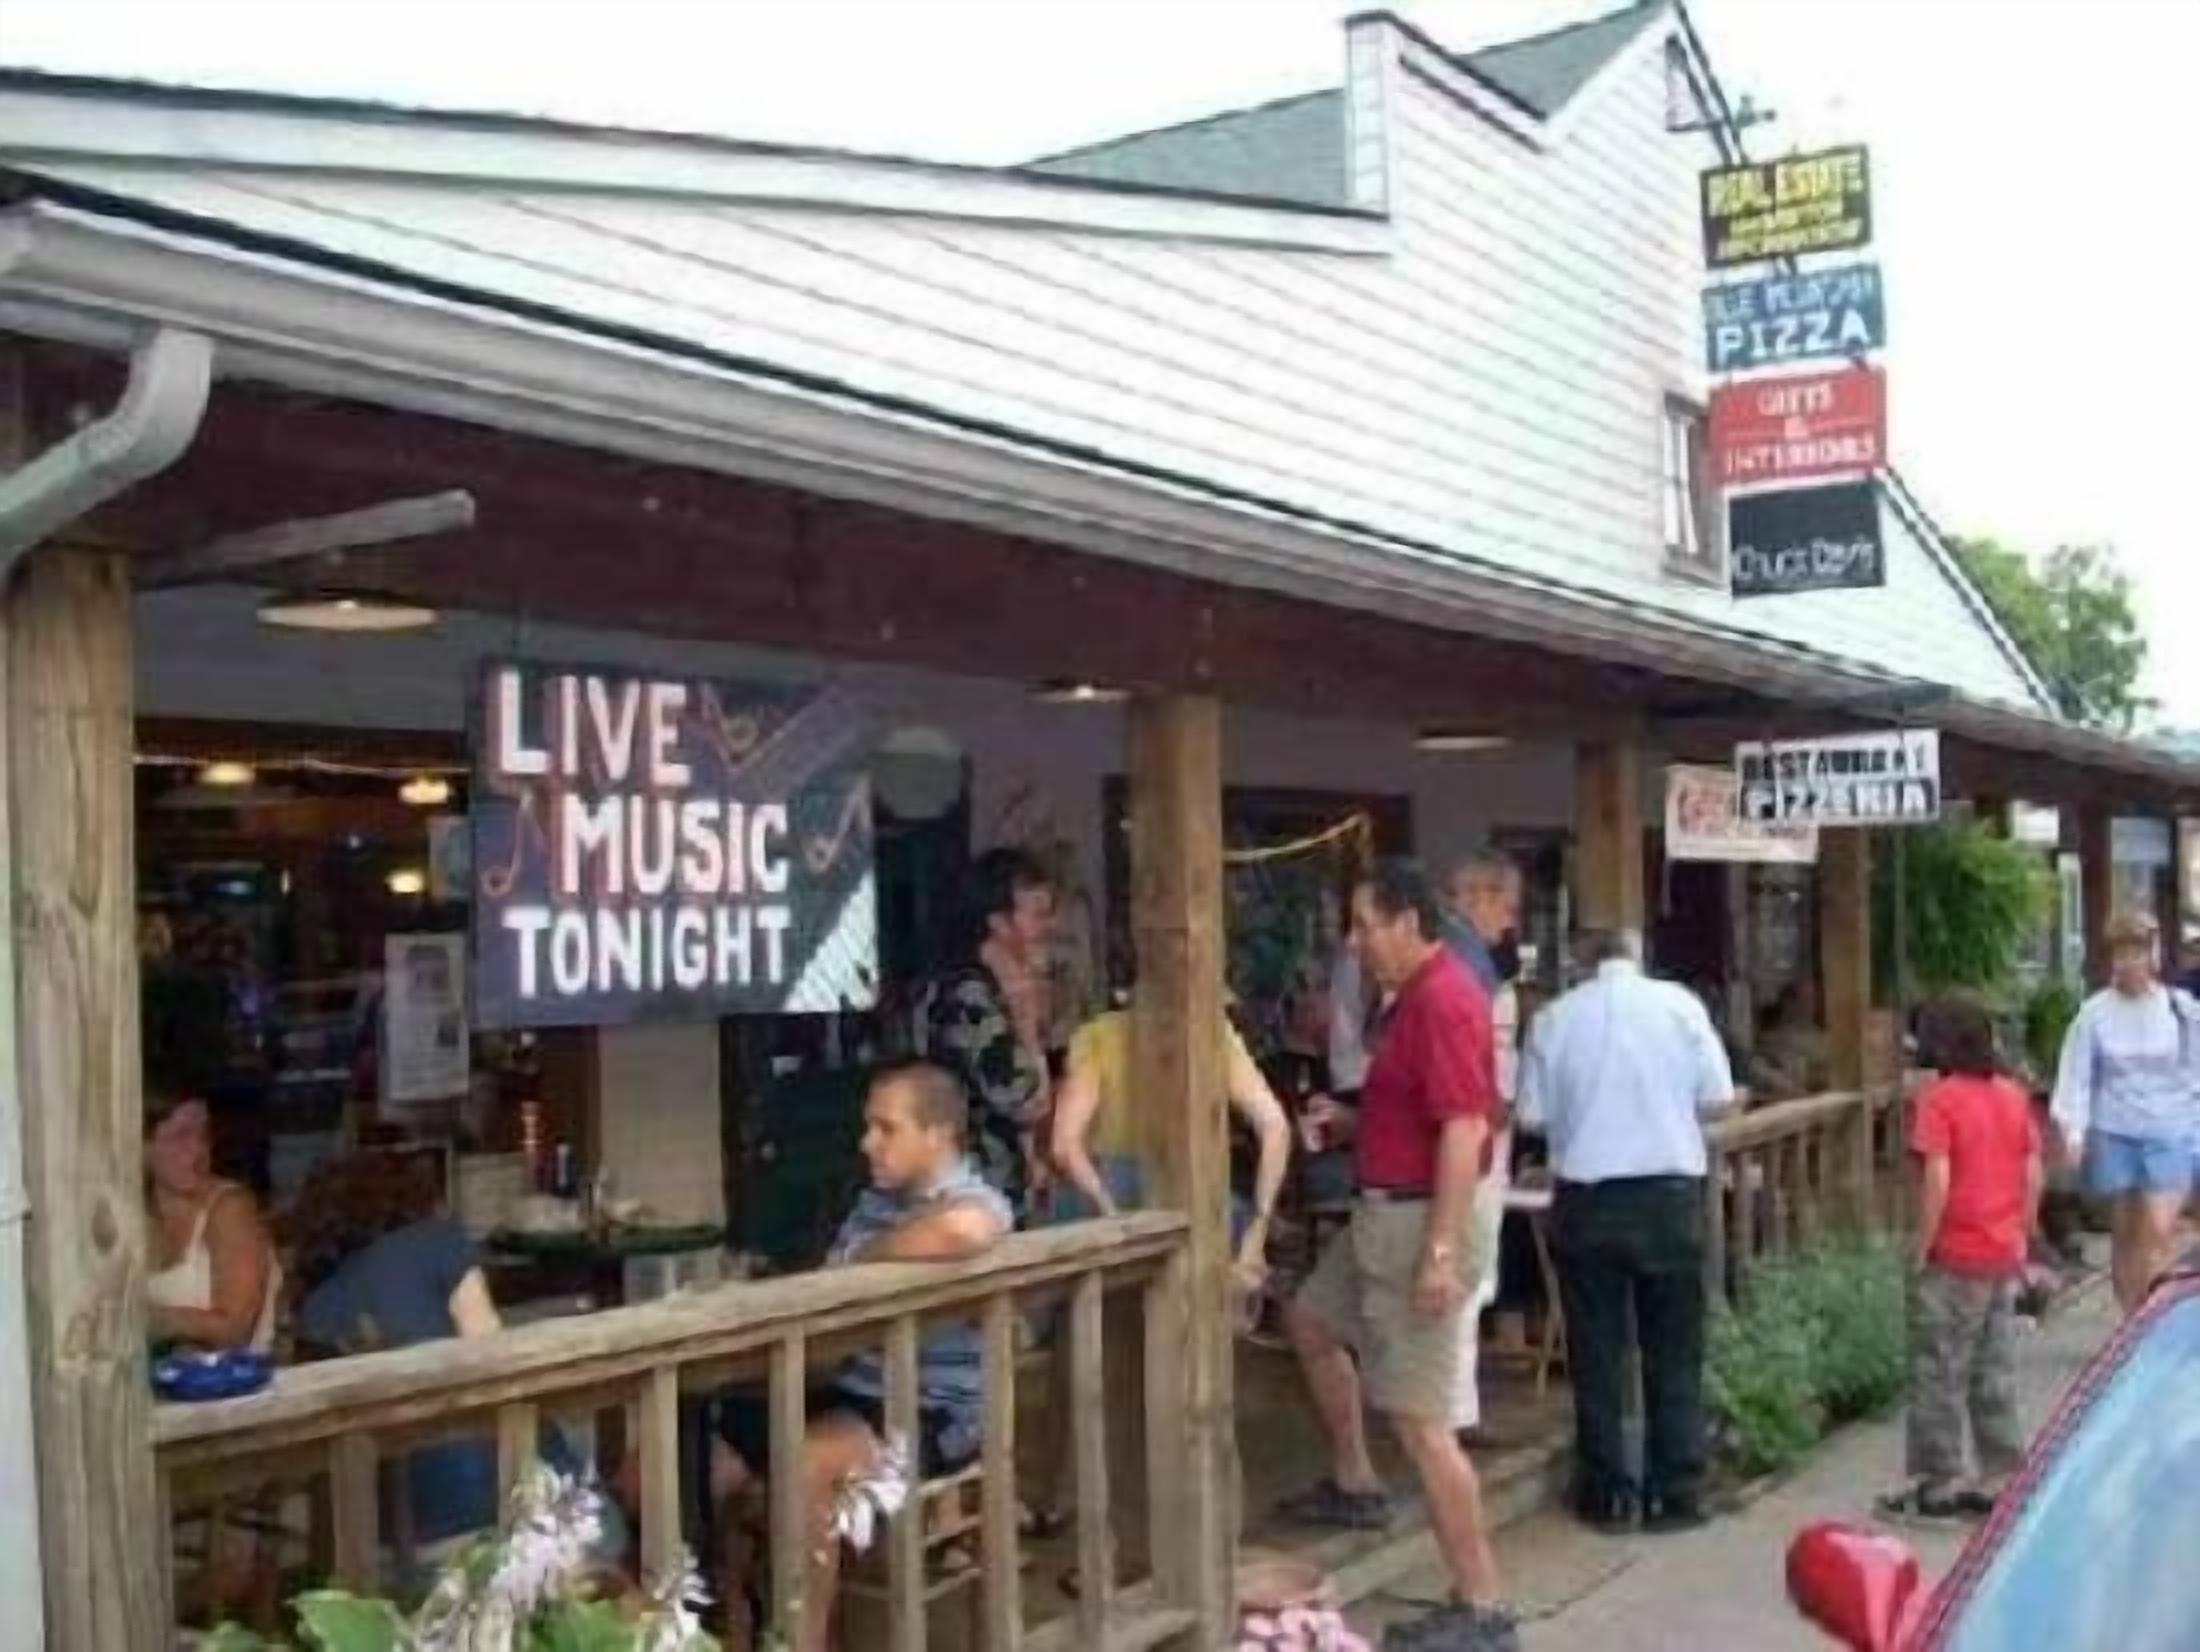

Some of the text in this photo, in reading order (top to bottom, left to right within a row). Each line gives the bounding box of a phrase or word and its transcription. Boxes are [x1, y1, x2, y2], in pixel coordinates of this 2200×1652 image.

[1775, 152, 1863, 202] ESTATE
[1715, 306, 1872, 366] PIZZA
[499, 668, 692, 787] LIVE
[560, 794, 790, 895] MUSIC
[503, 906, 793, 999] TONIGHT
